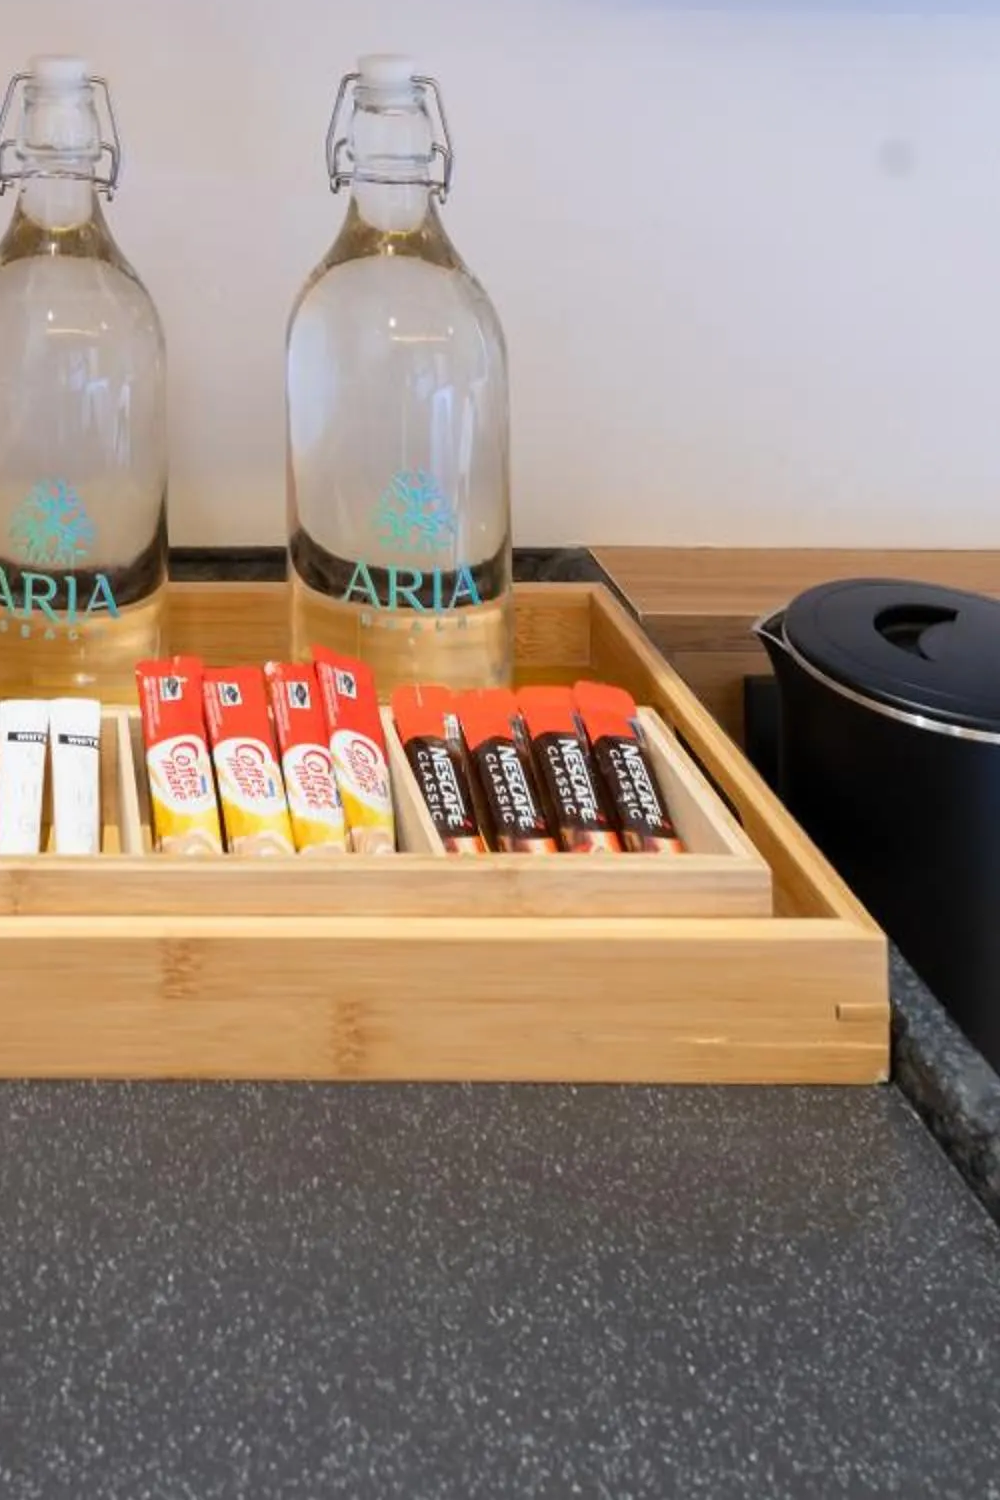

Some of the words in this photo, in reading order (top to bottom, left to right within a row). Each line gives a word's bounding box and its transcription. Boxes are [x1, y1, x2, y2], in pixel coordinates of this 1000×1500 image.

[343, 559, 483, 614] ARIA
[417, 751, 443, 821] CLASSIC
[485, 753, 515, 824] CLASSIC
[547, 745, 577, 815] CLASSIC
[609, 749, 643, 819] CLASSIC
